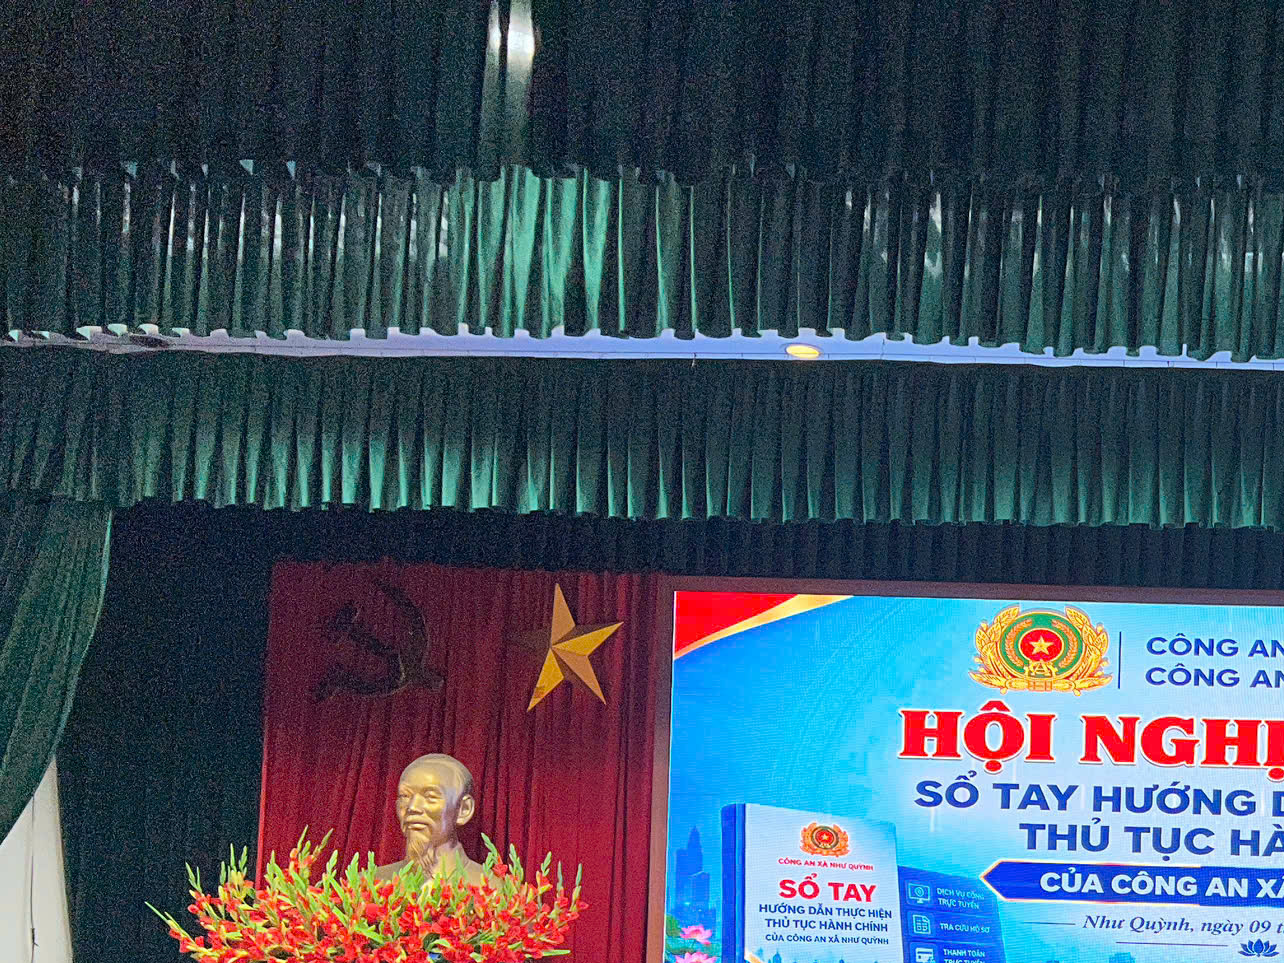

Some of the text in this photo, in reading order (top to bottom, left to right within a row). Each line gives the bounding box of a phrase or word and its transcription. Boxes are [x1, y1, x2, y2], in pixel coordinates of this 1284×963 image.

[1146, 633, 1239, 657] CÔNG
[1145, 663, 1240, 687] CÔNG
[899, 699, 1057, 774] HỘI
[914, 770, 979, 808] SỔ
[992, 783, 1079, 811] TAY
[1093, 781, 1256, 817] HƯỚNG
[1019, 817, 1110, 852] THỦ
[1124, 826, 1215, 861] TỤC
[778, 873, 877, 902] SỔ TAY
[1040, 867, 1104, 894] CỦA
[1112, 871, 1197, 896] CÔNG
[1205, 877, 1248, 898] AN
[759, 902, 805, 915] HƯỚNG
[836, 907, 866, 919] THỰC
[868, 908, 892, 920] HIỆN
[765, 916, 888, 932] THỦ TỤC HÀNH CHÍNH
[1082, 915, 1125, 930] Như
[1129, 917, 1194, 934] Quỳnh,
[1201, 919, 1244, 936] ngày
[1249, 920, 1271, 934] 09
